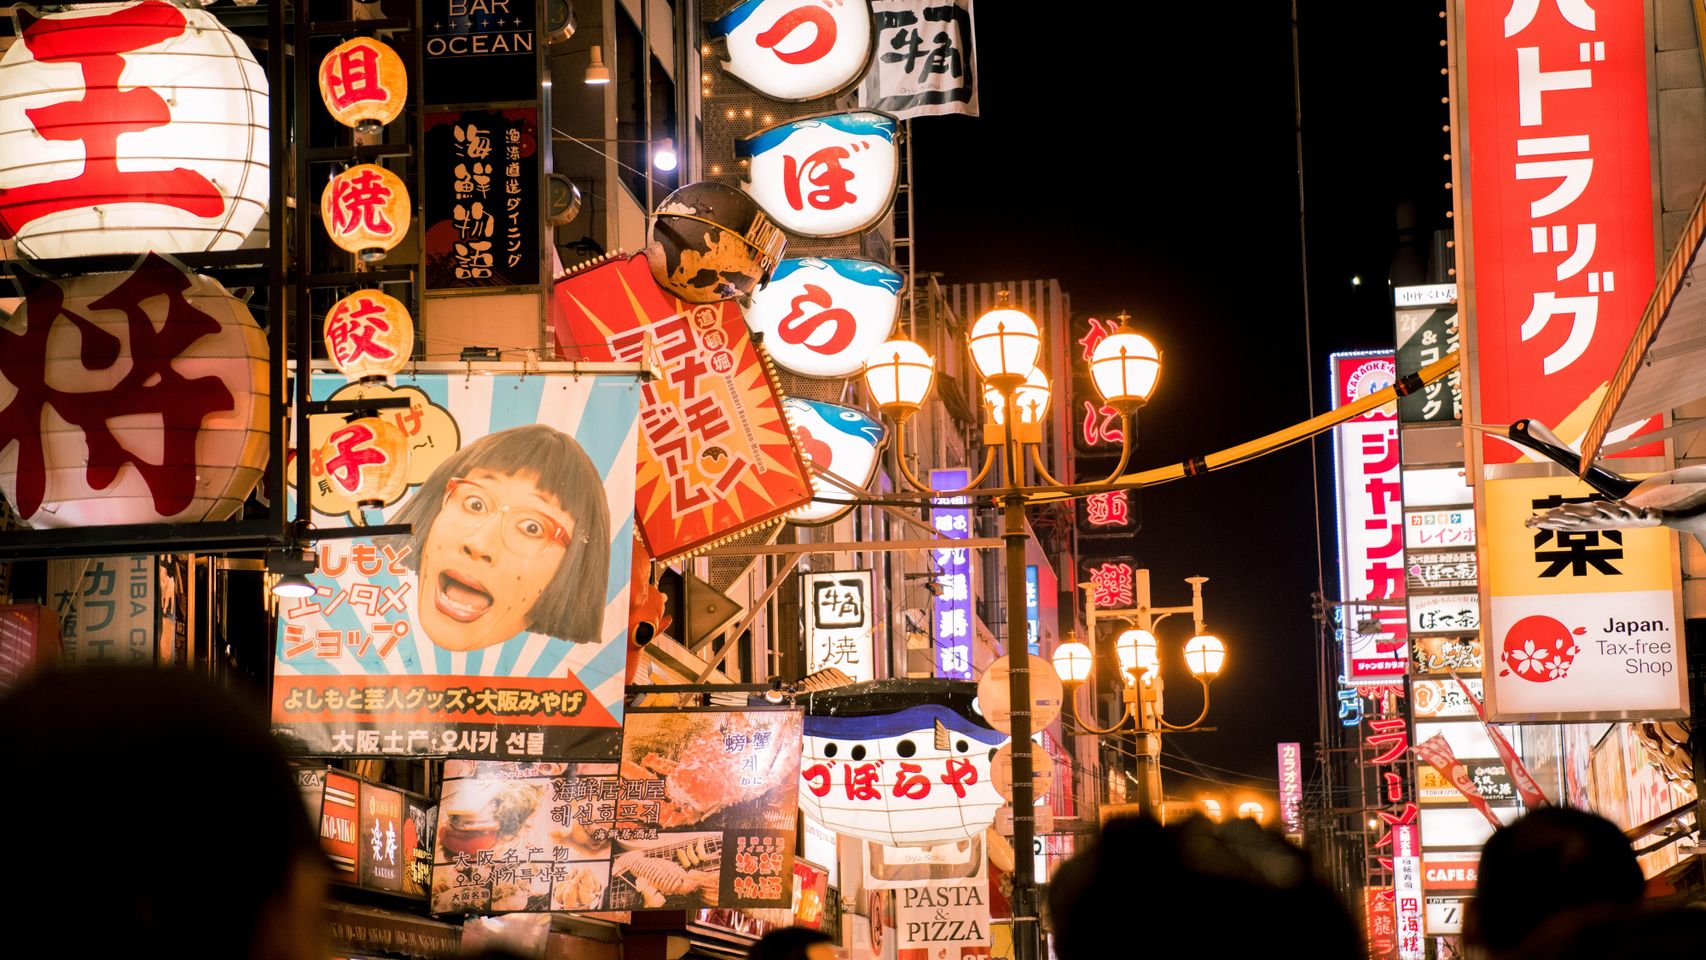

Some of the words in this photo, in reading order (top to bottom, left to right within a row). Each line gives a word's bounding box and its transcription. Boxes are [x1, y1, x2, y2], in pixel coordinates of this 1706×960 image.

[449, 0, 511, 17] BAR
[426, 33, 533, 57] OCEAN
[880, 27, 963, 84] 牛角
[0, 0, 226, 240] 王
[783, 140, 871, 212] ぼ
[453, 123, 496, 279] 海鮮物語
[552, 189, 567, 209] 2
[777, 283, 857, 356] ら
[693, 306, 735, 374] 道頓堀
[611, 329, 711, 513] ミージアム
[1361, 427, 1409, 654] ジャンカラ
[313, 543, 413, 577] しもと
[286, 582, 412, 620] エンタメ
[821, 588, 859, 619] 牛角
[283, 619, 411, 660] ショップ
[1602, 617, 1671, 637] Japan.
[129, 627, 147, 666] CA
[1596, 638, 1672, 657] Tax-free
[1625, 657, 1674, 677] Shop
[284, 686, 585, 718] よしもと芸人グッズ・大阪みやげ
[505, 731, 546, 756] 선물
[552, 778, 667, 802] 海鮮居酒屋
[739, 776, 762, 786] かに
[802, 757, 979, 801] づぼらや
[551, 802, 661, 827] 해선호프집
[593, 828, 659, 842] 海鮮居酒屋
[452, 845, 570, 869] 大阪名产物
[1426, 868, 1465, 881] CAFE
[1466, 868, 1478, 881] &
[903, 886, 984, 909] PASTA
[934, 910, 950, 921] &
[906, 920, 984, 943] PIZZA
